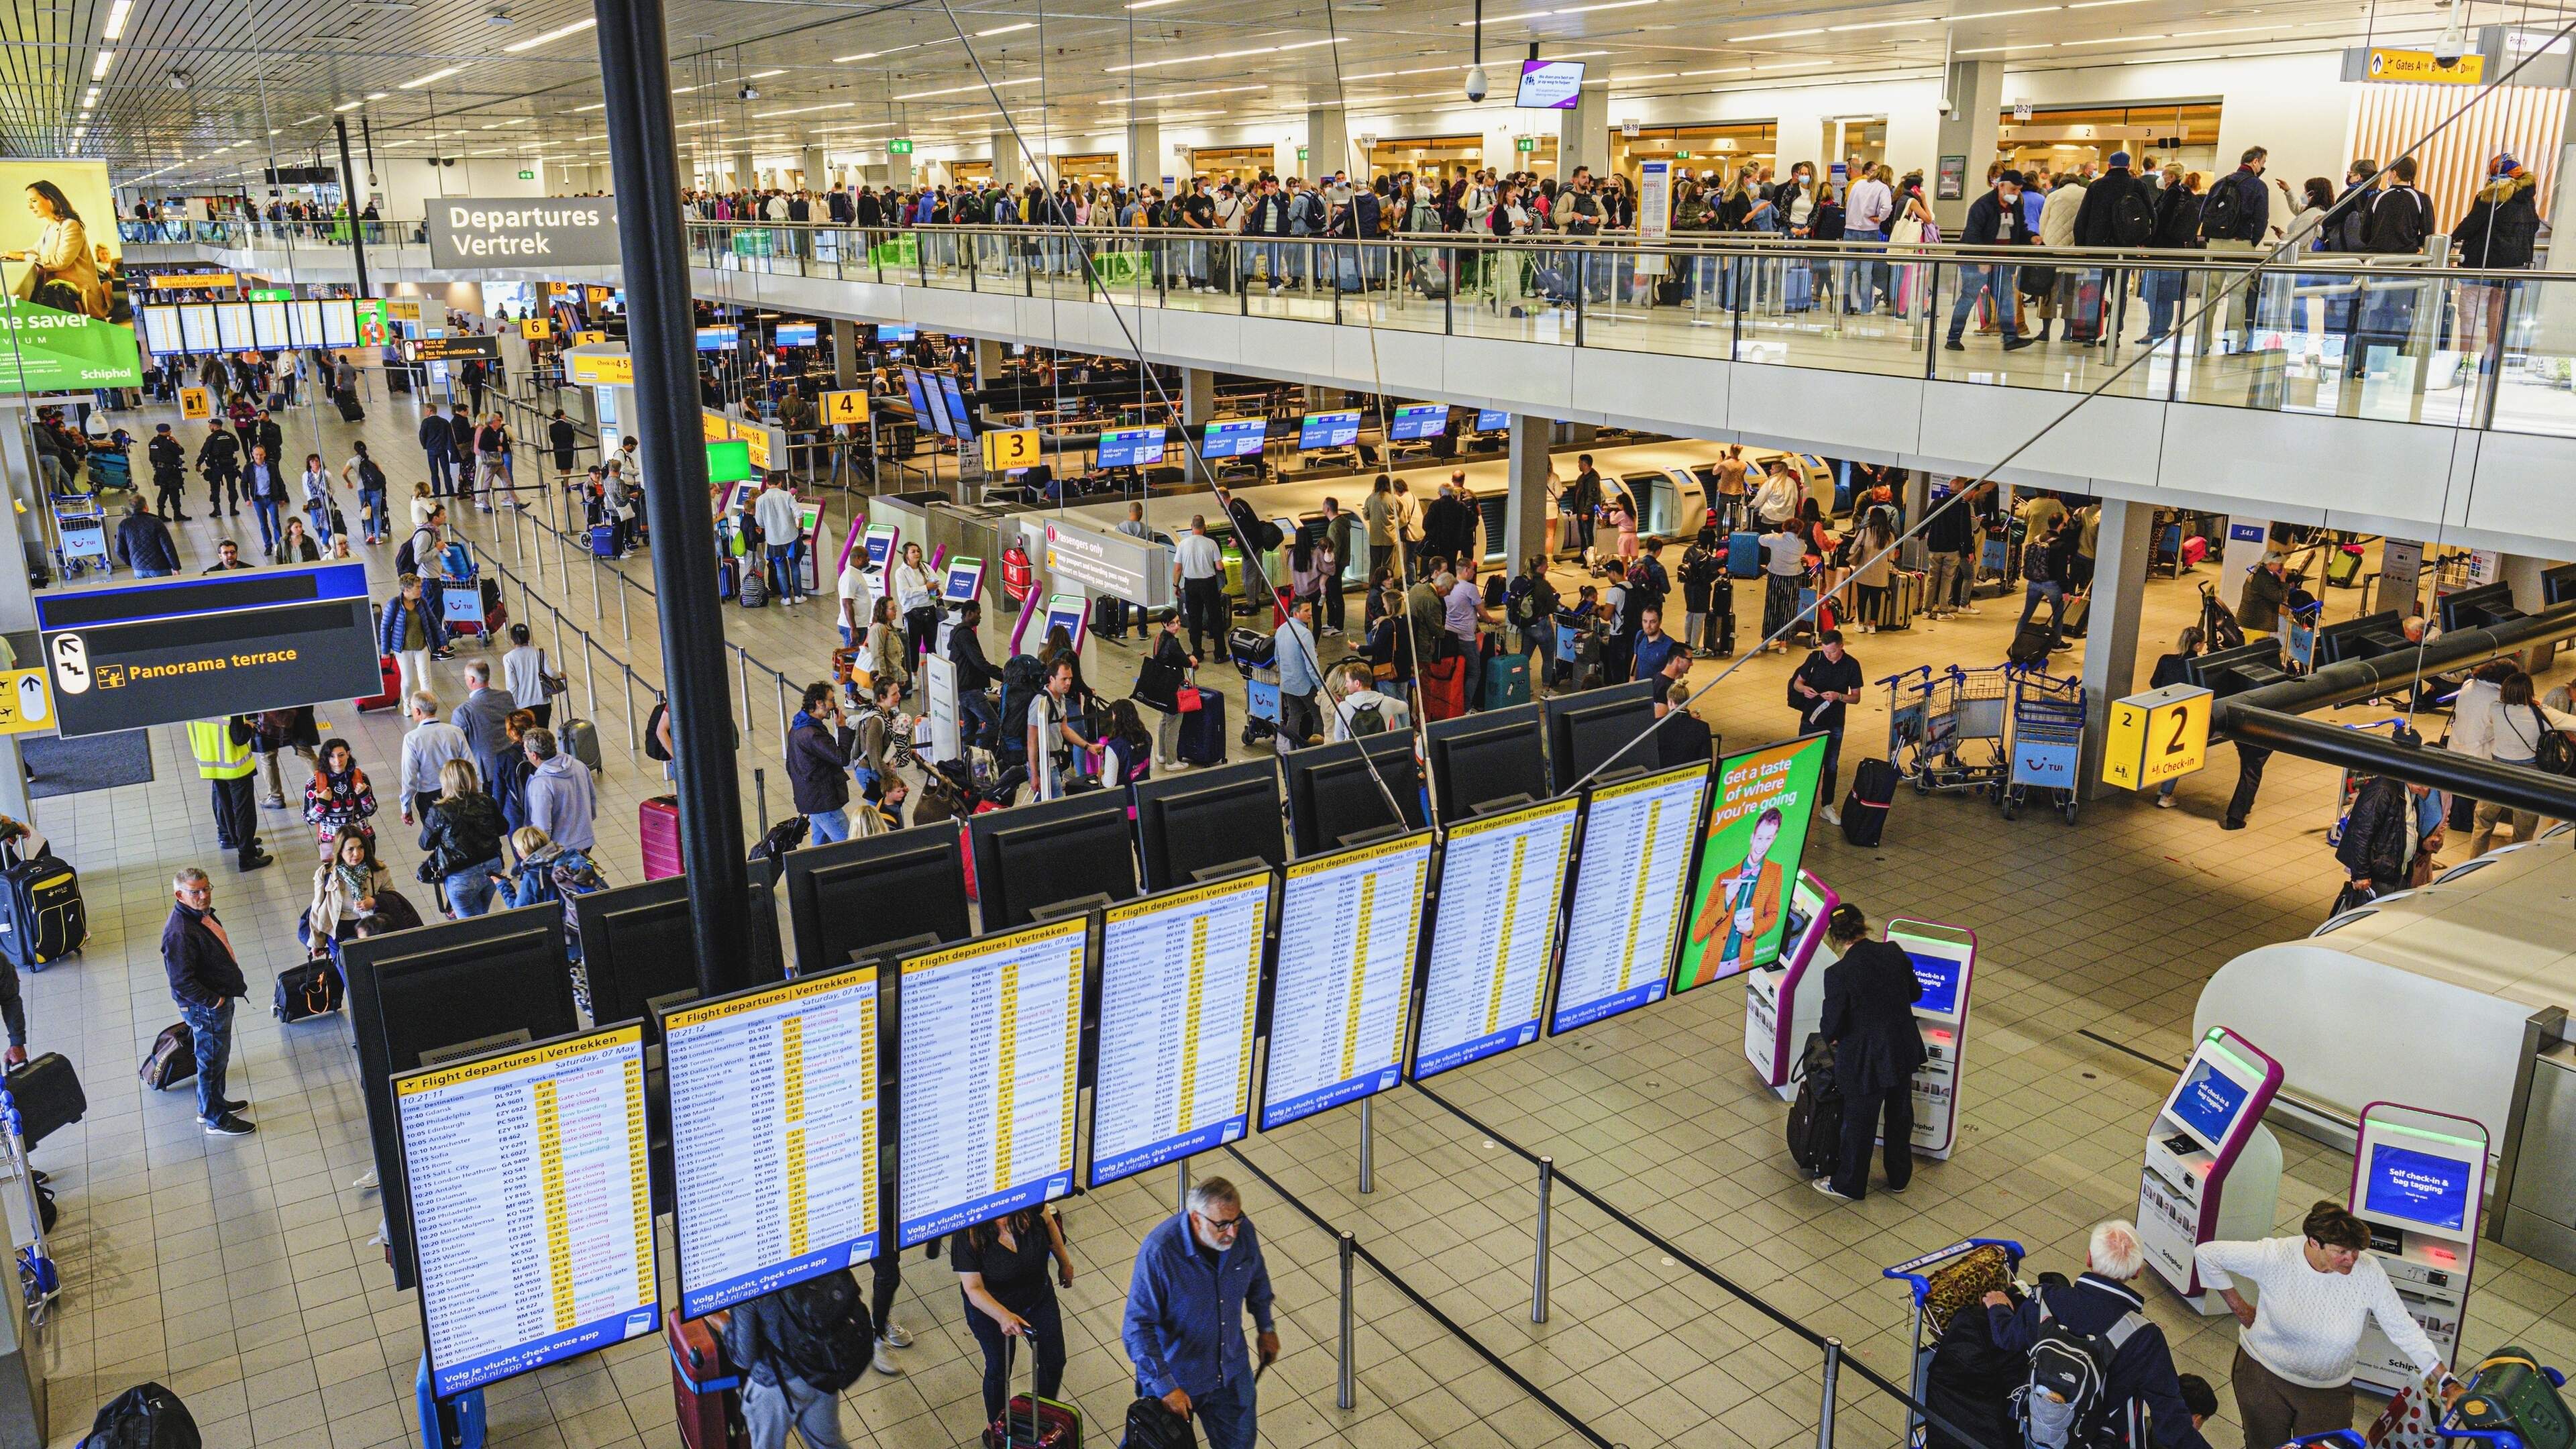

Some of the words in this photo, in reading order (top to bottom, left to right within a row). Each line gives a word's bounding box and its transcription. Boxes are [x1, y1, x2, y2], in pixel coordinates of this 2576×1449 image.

[2396, 60, 2414, 70] Gates
[2015, 104, 2031, 113] 20-21
[450, 207, 600, 233] Departures
[451, 232, 551, 255] Vertrek
[555, 282, 561, 290] 8
[595, 288, 601, 297] 7
[29, 313, 91, 329] saver
[531, 321, 540, 333] 6
[586, 333, 594, 343] 5
[80, 368, 132, 380] Schiphol
[616, 360, 621, 368] 4
[623, 360, 628, 368] 5
[840, 394, 853, 413] 4
[1010, 434, 1024, 457] 3
[1057, 531, 1088, 549] Passengers
[1089, 543, 1103, 557] only
[1066, 557, 1082, 568] passport
[1090, 565, 1108, 578] boarding
[1118, 575, 1129, 585] ready
[1079, 571, 1095, 584] boarding
[1104, 581, 1132, 596] gereedhouden
[129, 658, 226, 680] Panorama
[231, 649, 297, 667] terrace
[1266, 700, 1274, 708] TUI
[2123, 712, 2133, 727] 2
[2165, 706, 2188, 756] 2
[1723, 768, 1747, 786] Get
[1749, 768, 1757, 779] a
[1760, 758, 1792, 777] taste
[2163, 757, 2194, 773] Check-in
[1603, 788, 1622, 798] Flight
[1623, 780, 1658, 793] departures
[1663, 770, 1697, 783] Vertrekken
[1726, 785, 1743, 802] of
[1743, 777, 1784, 798] where
[1760, 790, 1798, 814] going
[1461, 824, 1482, 835] Flight
[1483, 816, 1522, 829] departures
[1528, 805, 1566, 818] Vertrekken
[1301, 863, 1324, 874] Flight
[1326, 852, 1369, 867] departures
[1376, 840, 1417, 855] Vertrekken
[1122, 906, 1148, 917] Flight
[1150, 894, 1199, 910] departures
[1206, 881, 1253, 896] Vertrekken
[920, 955, 949, 967] Flight
[952, 942, 1006, 959] departures
[1015, 926, 1068, 944] Vertrekken
[1915, 970, 1939, 980] check-in
[1918, 977, 1941, 987] tagging
[688, 1008, 720, 1022] Flight
[724, 994, 786, 1013] departures
[796, 976, 856, 996] Vertrekken
[670, 1024, 706, 1039] 10:21:12
[802, 994, 839, 1006] Saturday,
[854, 985, 871, 994] May
[422, 1072, 460, 1087] Flight
[465, 1055, 536, 1077] departures
[547, 1036, 617, 1057] Vertrekken
[404, 1089, 443, 1105] 10:21:11
[555, 1055, 598, 1069] Saturday,
[602, 1049, 613, 1058] 07
[616, 1045, 636, 1055] May
[424, 1095, 464, 1108] Destination
[494, 1083, 513, 1091] Flight
[527, 1074, 555, 1083] Check-in
[556, 1067, 583, 1077] Remarks
[2199, 1081, 2208, 1091] Self
[2207, 1089, 2225, 1105] check-in
[406, 1122, 425, 1130] 10:00
[426, 1112, 471, 1126] Philadelphia
[507, 1097, 523, 1106] 9601
[2206, 1096, 2224, 1113] tagging
[2389, 1168, 2406, 1177] Self
[2406, 1173, 2440, 1185] check-in
[2393, 1176, 2409, 1187] bag
[2410, 1181, 2443, 1195] tagging
[2162, 1248, 2183, 1271] Schiphol
[444, 1371, 469, 1383] Volg
[472, 1368, 482, 1377] je
[484, 1356, 519, 1371] vlucht,
[522, 1345, 550, 1359] check
[553, 1338, 577, 1350] onze
[580, 1331, 599, 1341] app
[446, 1363, 522, 1391] schiphol.nl/app
